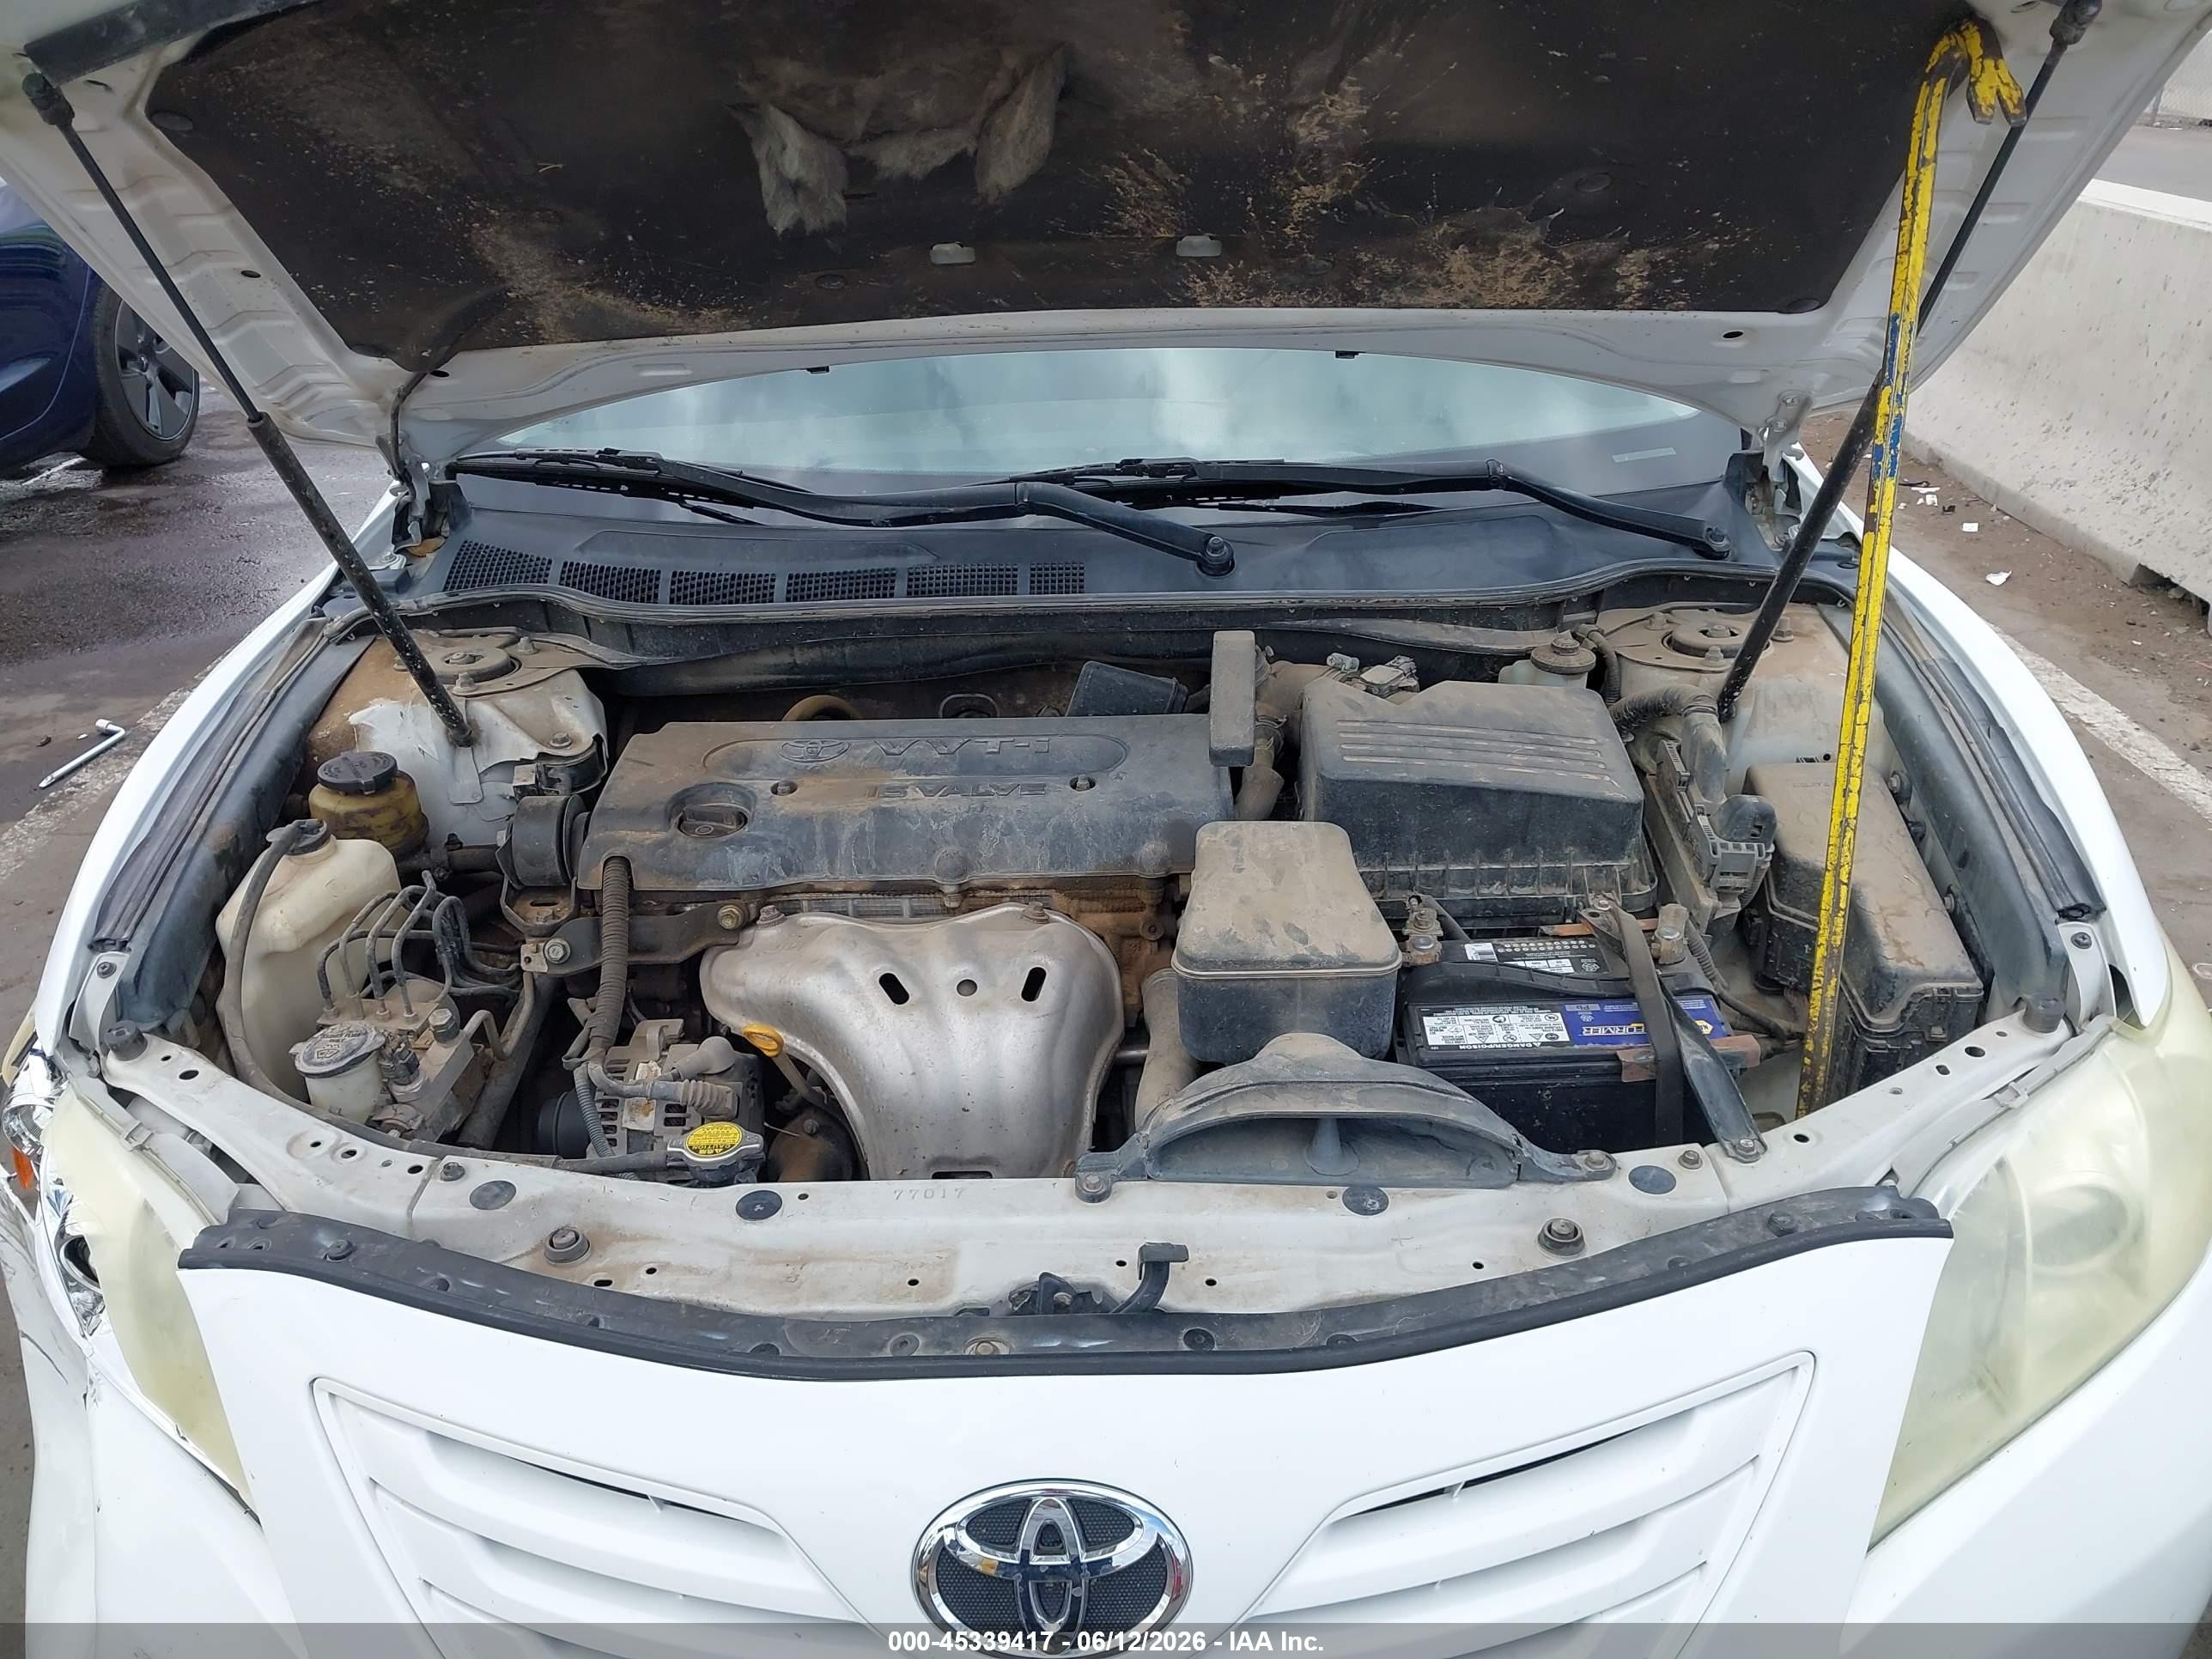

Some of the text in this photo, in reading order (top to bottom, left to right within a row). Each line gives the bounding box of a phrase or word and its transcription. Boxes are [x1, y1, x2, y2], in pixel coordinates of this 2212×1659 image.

[915, 782, 1047, 798] VALVE
[1582, 1025, 1644, 1036] FORMER
[893, 1188, 965, 1200] 77017
